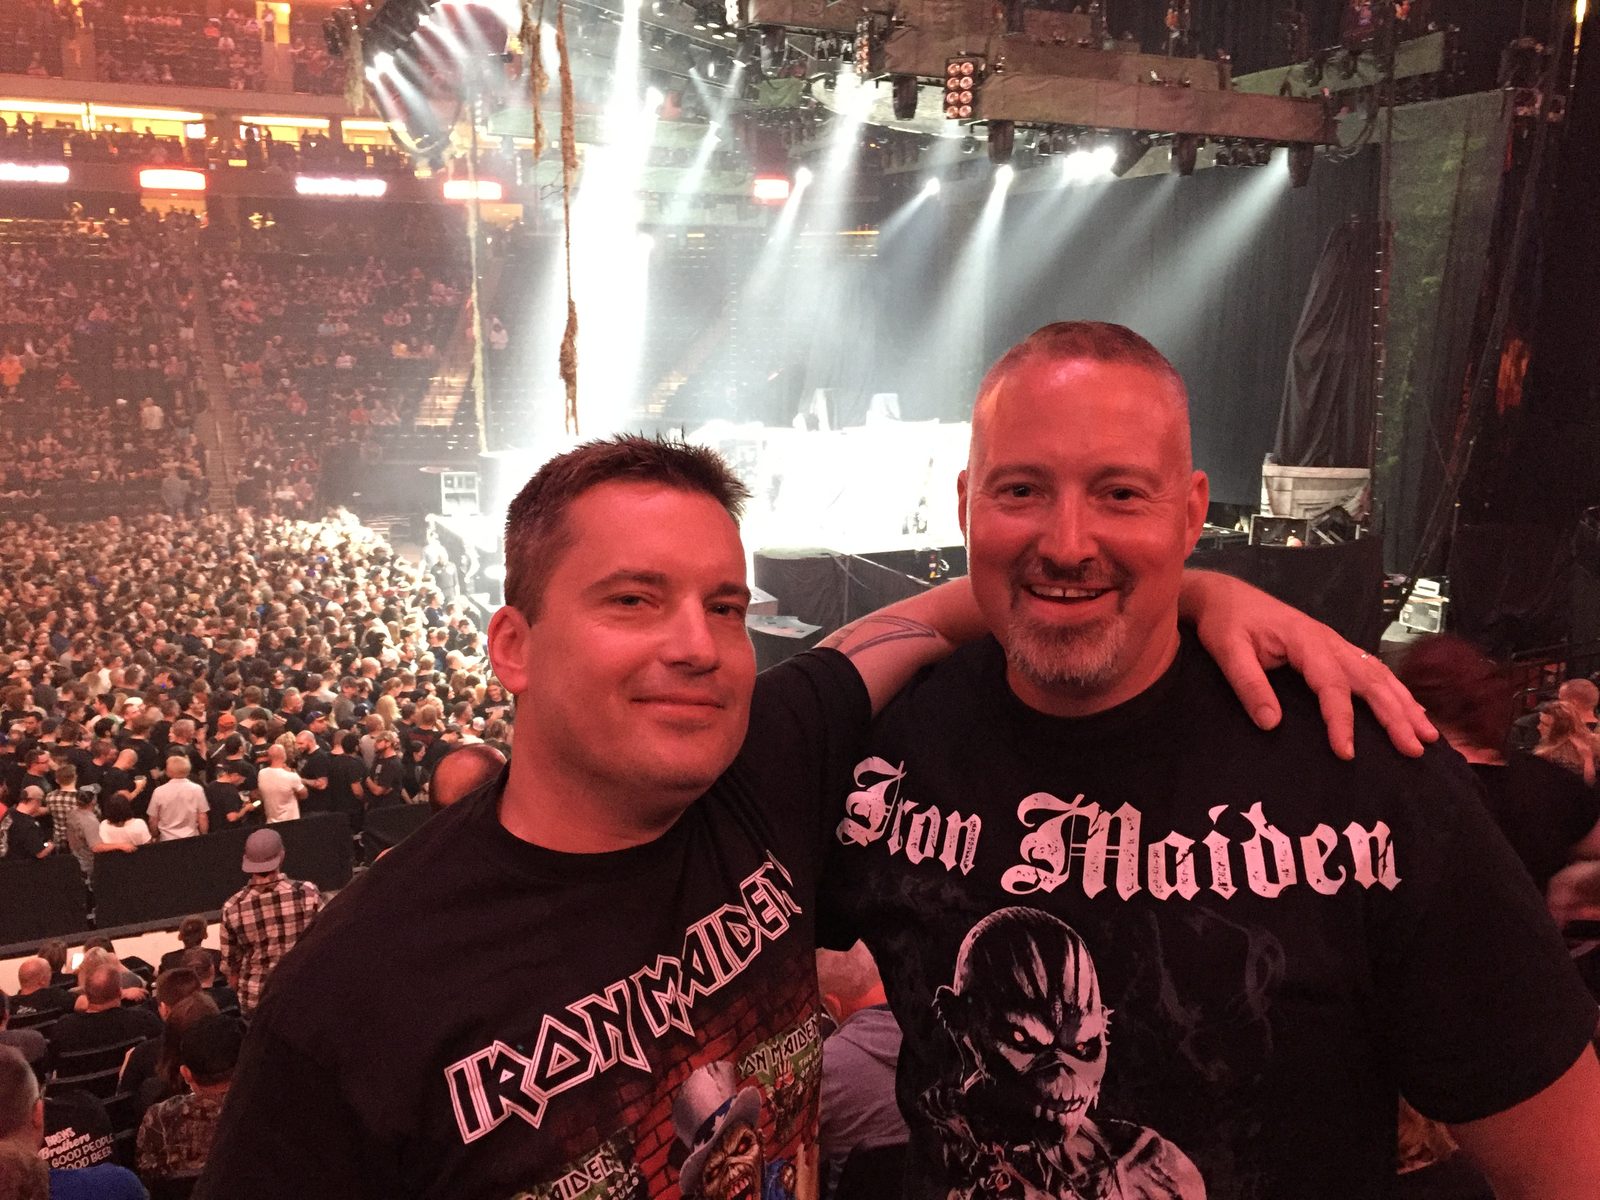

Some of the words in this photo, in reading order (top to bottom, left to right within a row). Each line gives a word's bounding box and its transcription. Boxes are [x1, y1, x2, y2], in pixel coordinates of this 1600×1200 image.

[835, 756, 982, 876] Iron
[1000, 792, 1402, 901] Maiden
[443, 979, 652, 1145] IRON
[629, 850, 802, 1038] MAIDEN
[51, 1148, 82, 1168] GOOD
[60, 1156, 90, 1170] OOD
[90, 1146, 113, 1164] BEER
